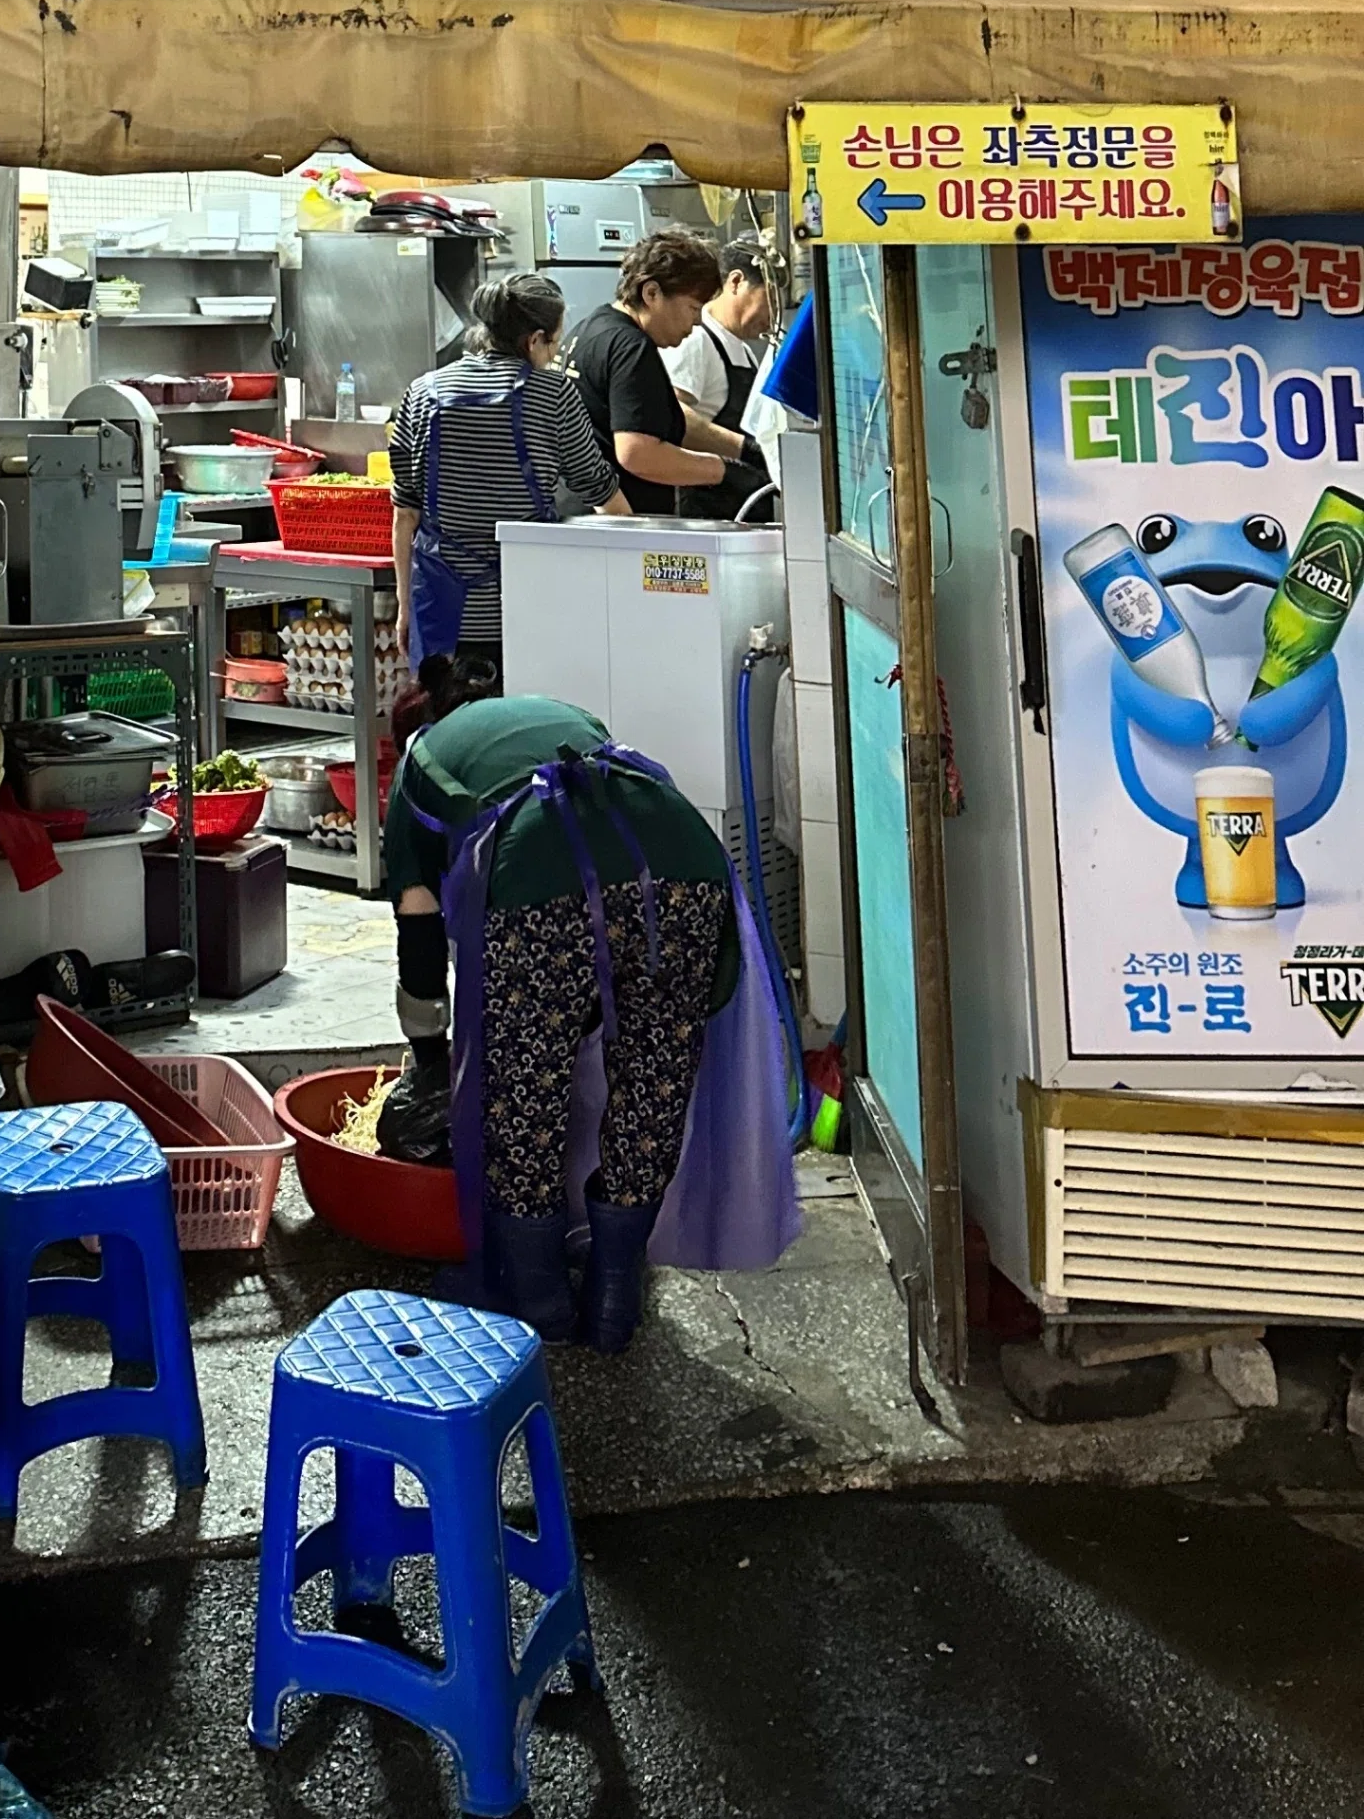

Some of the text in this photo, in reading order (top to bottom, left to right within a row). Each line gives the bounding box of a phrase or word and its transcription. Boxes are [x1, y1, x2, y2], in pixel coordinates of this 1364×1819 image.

[843, 124, 1177, 170] 손님은 좌측정문을
[938, 177, 1187, 222] 이용해주세요.
[1047, 242, 1361, 311] 백제정육점
[1068, 353, 1364, 469] 테진아
[1297, 558, 1352, 603] TERRA
[1207, 813, 1267, 837] TERRA
[1123, 952, 1244, 977] 소주의 원조
